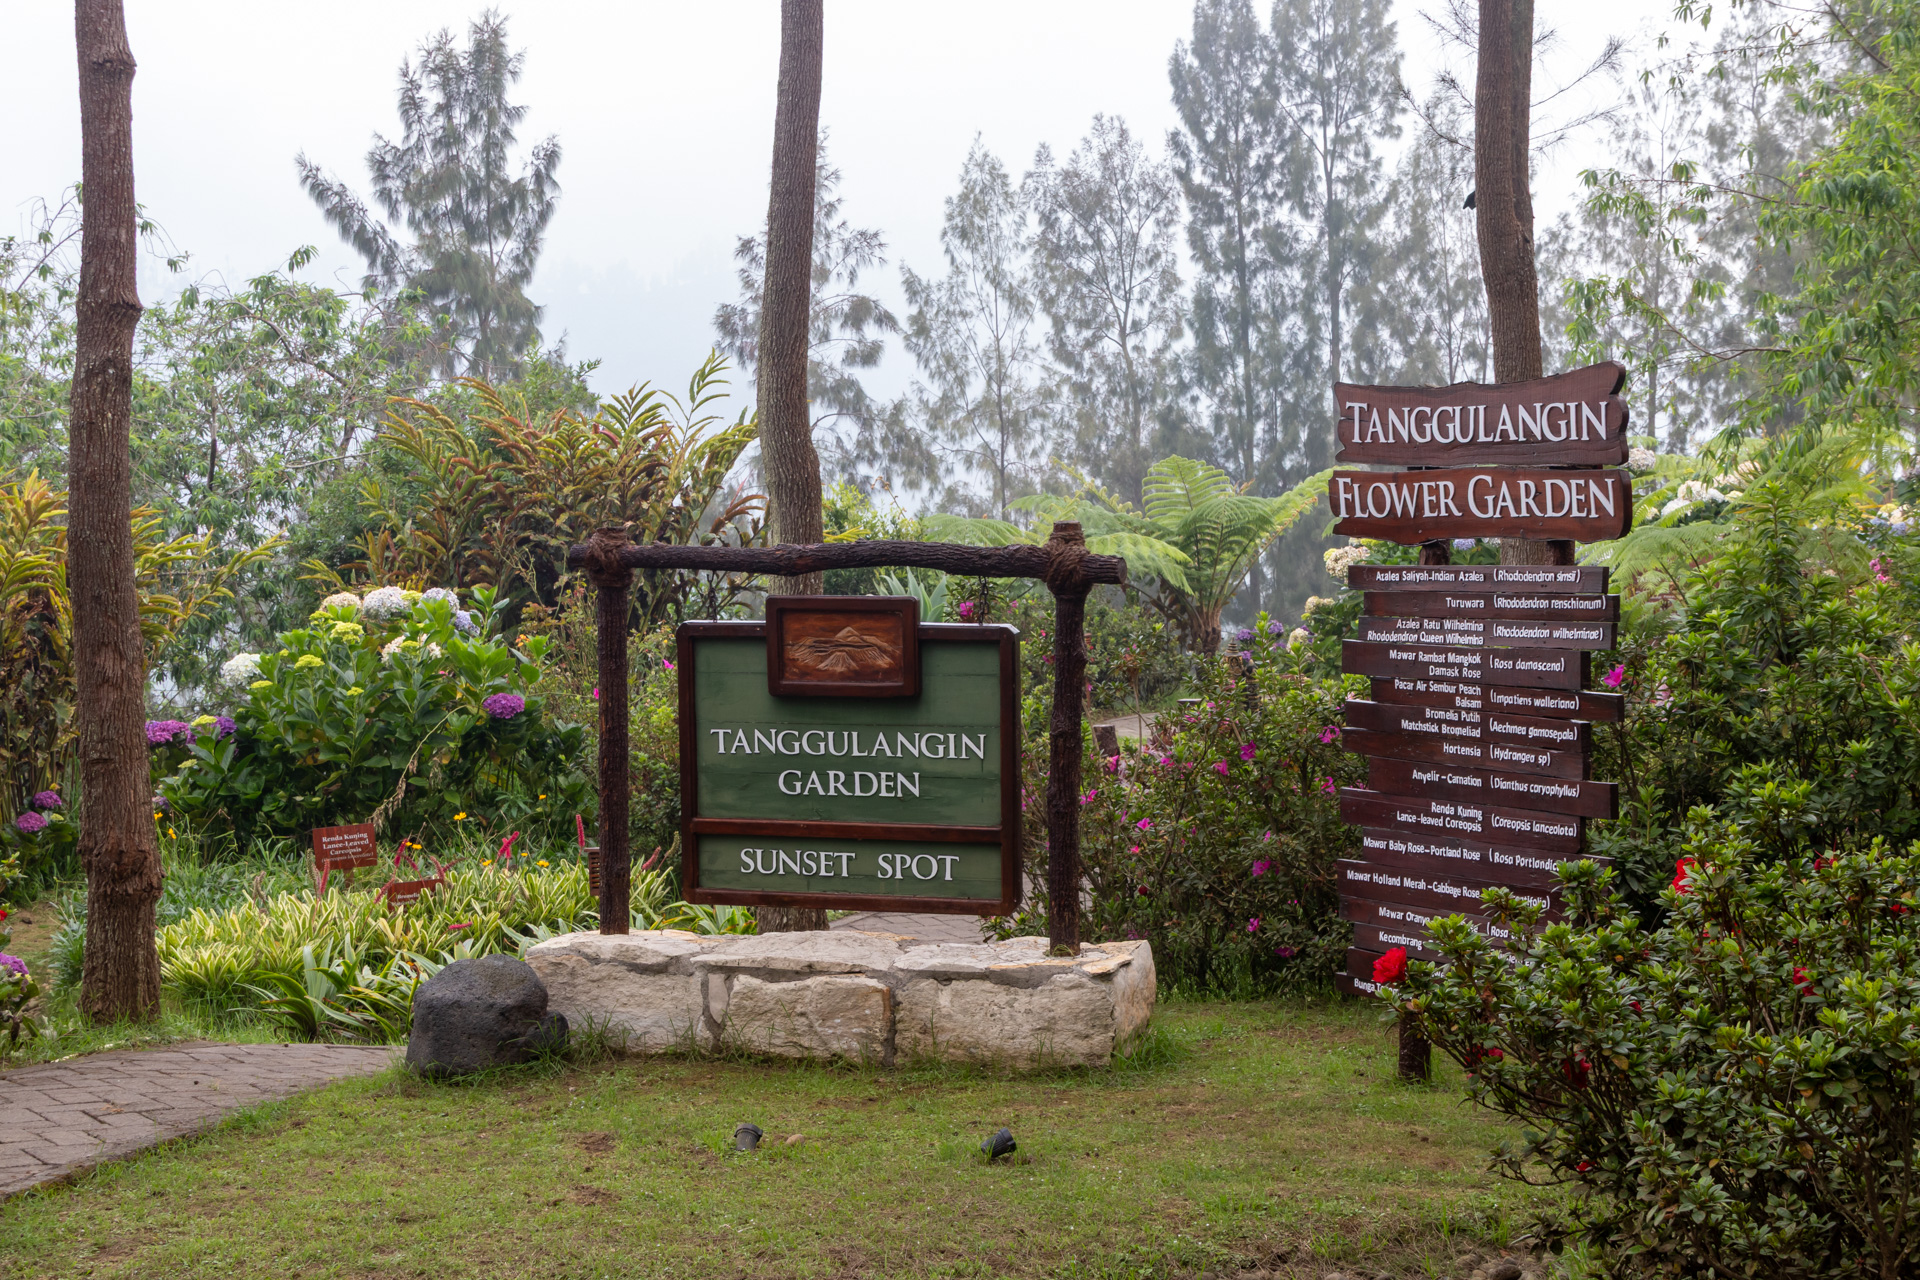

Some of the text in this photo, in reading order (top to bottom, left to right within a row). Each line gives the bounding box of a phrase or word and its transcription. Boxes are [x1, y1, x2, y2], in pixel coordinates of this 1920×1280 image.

[1346, 401, 1609, 444] TANGGULANGIN
[1335, 475, 1616, 519] FLOWER GARDEN
[1375, 571, 1400, 581] Azalea
[1459, 571, 1484, 582] Azalea
[1445, 597, 1485, 608] Turuwara
[1396, 618, 1484, 632] Azalea Ratu Wilhelmina
[1367, 630, 1484, 645] Rhododendron Queen Wilhelmina
[1389, 649, 1482, 666] Mawar Rambat Mangkok
[1429, 665, 1481, 678] Damask Rose
[1394, 679, 1481, 696] Pacar Air Sembur Peach
[1455, 696, 1482, 708] Balsam
[1425, 708, 1481, 723] Bromelia Putih
[1401, 719, 1481, 738] Matchstick Bromeliad
[710, 728, 986, 760] TANGGULANGIN
[1443, 742, 1481, 757] Hortensia
[778, 769, 920, 798] GARDEN
[1431, 801, 1483, 821] Renda Kuning
[1445, 817, 1482, 833] Coreopsis
[322, 832, 368, 843] Renda Kuning
[1363, 836, 1387, 849] Mawar
[1388, 840, 1407, 854] Baby
[1462, 848, 1481, 861] Rose
[740, 847, 960, 881] SUNSET SPOT
[1346, 869, 1371, 882] Mawar
[1372, 872, 1401, 887] Holland
[1403, 877, 1426, 890] Merah
[1462, 886, 1480, 899] Rose
[1378, 907, 1405, 921] Mawar
[1379, 931, 1423, 950] Kecombrang
[1354, 978, 1376, 993] Bunga
